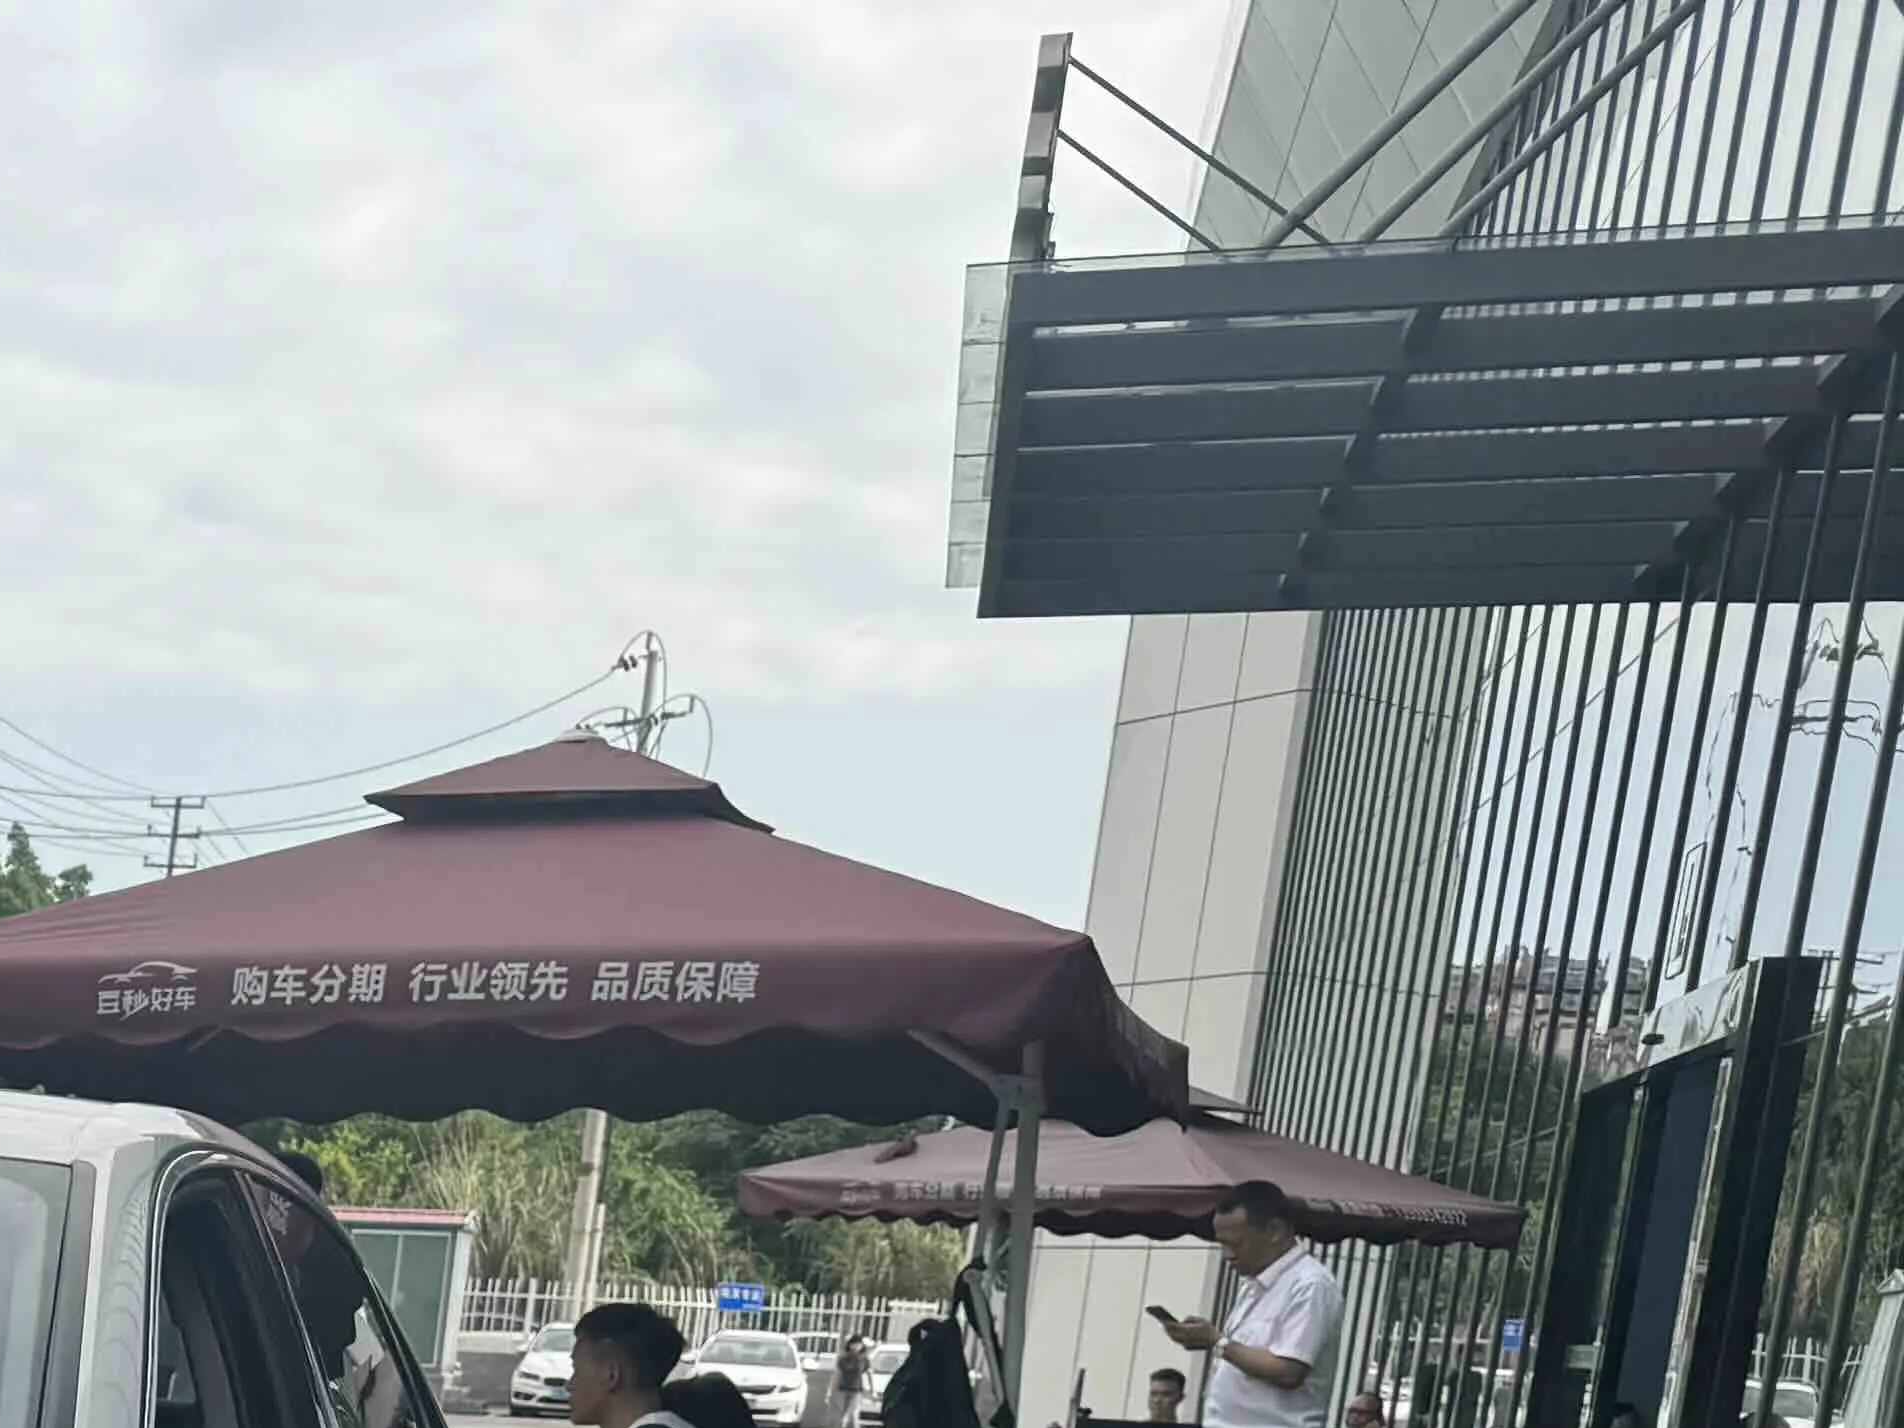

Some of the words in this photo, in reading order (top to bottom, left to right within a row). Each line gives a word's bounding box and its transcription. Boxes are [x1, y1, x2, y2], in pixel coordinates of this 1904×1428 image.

[231, 964, 387, 1006] 购车分期
[408, 960, 569, 1002] 行业领先
[590, 960, 761, 1003] 品质保障
